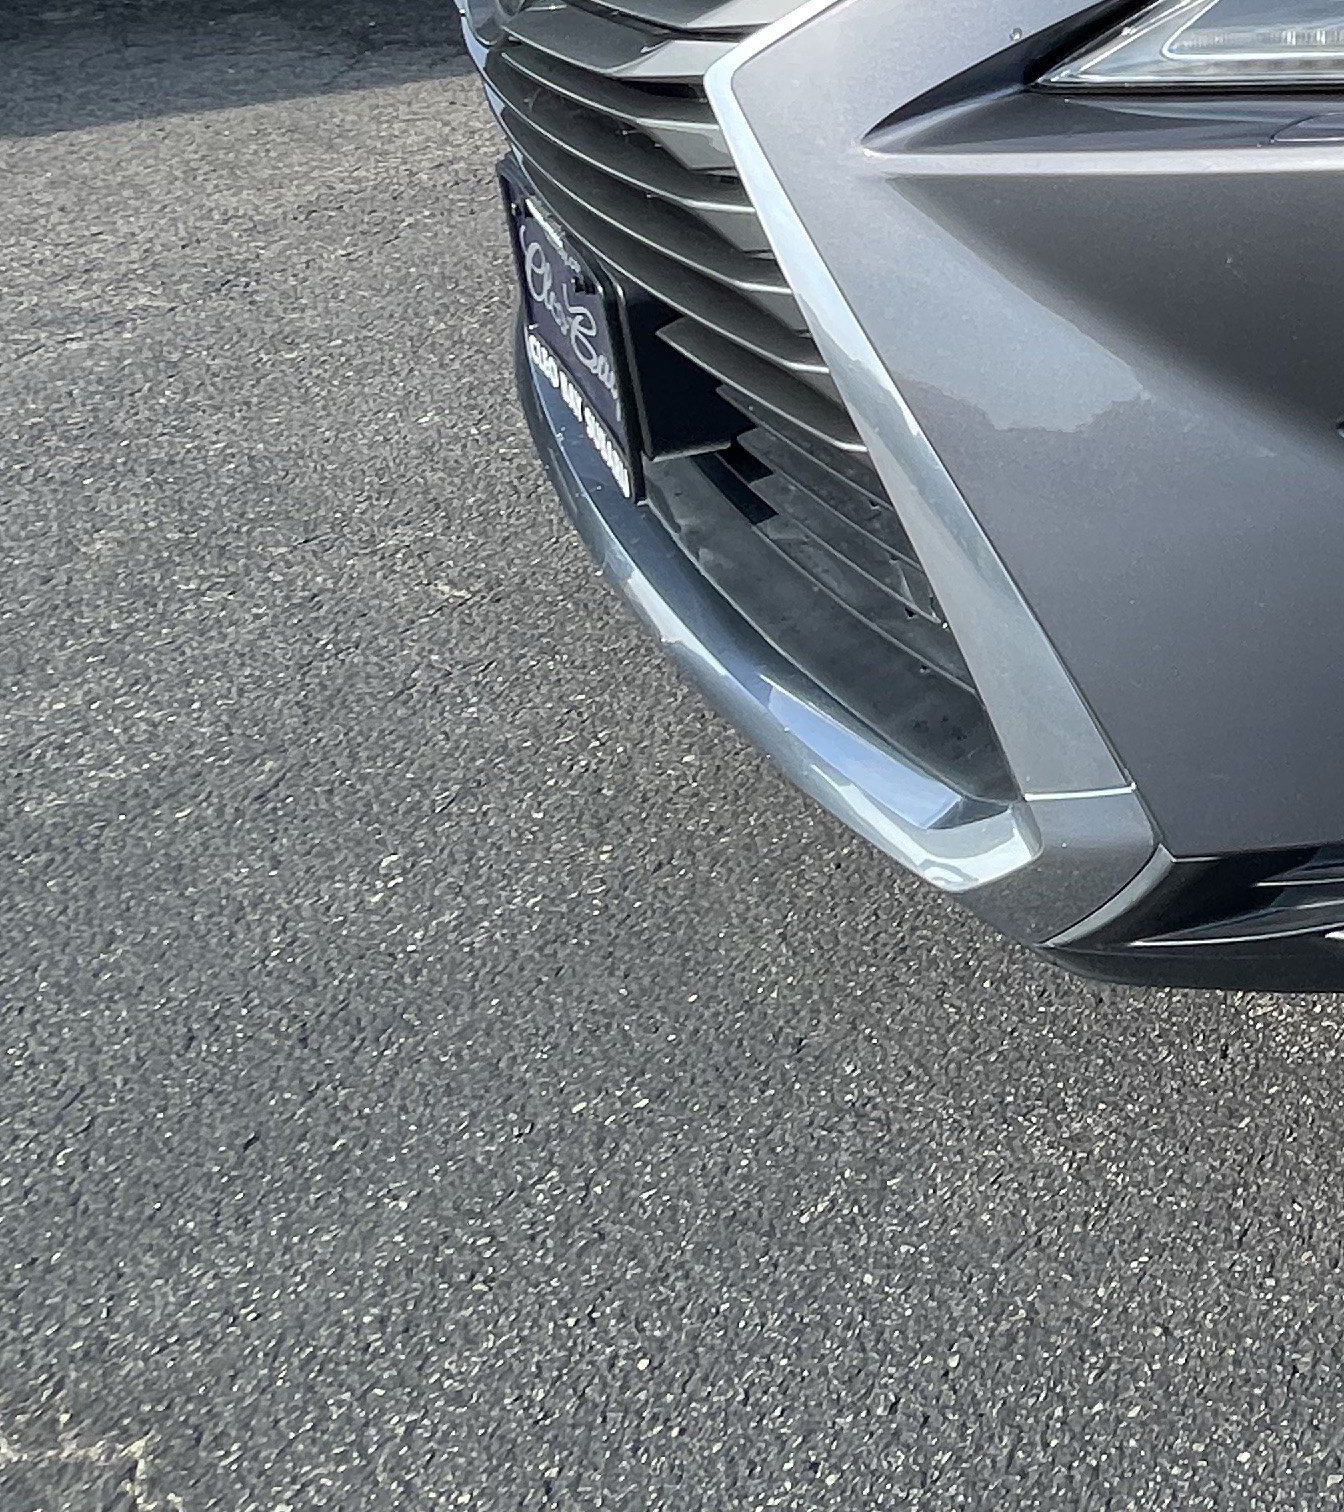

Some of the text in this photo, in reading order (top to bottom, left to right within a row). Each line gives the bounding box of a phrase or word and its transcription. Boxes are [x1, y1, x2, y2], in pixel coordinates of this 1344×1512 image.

[529, 334, 630, 498] CLEO BAY SUBARU
